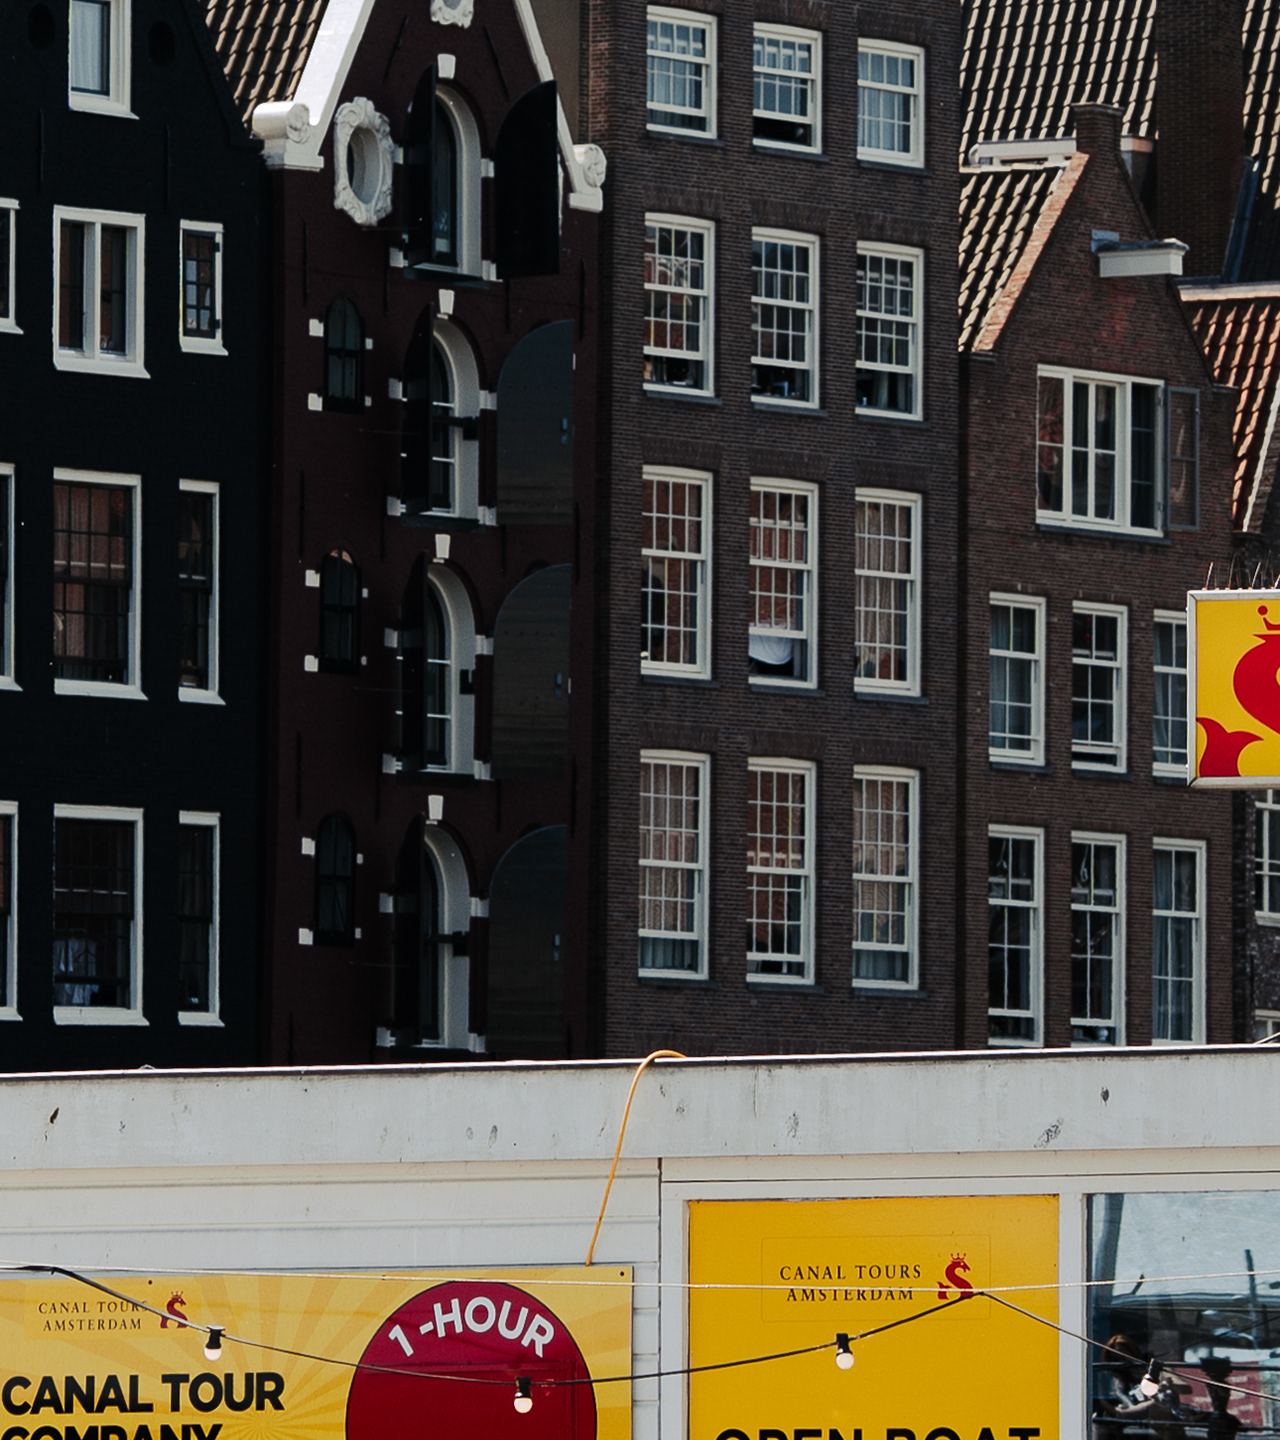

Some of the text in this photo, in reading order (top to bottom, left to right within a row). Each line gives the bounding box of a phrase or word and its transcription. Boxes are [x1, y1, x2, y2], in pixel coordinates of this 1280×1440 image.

[779, 1264, 921, 1280] CANAL TOURS
[786, 1286, 914, 1302] AMSTERDAM
[38, 1301, 90, 1314] CANAL
[42, 1317, 142, 1331] AMSTERDAM
[1, 1374, 154, 1416] CANAL
[161, 1371, 286, 1413] TOUR
